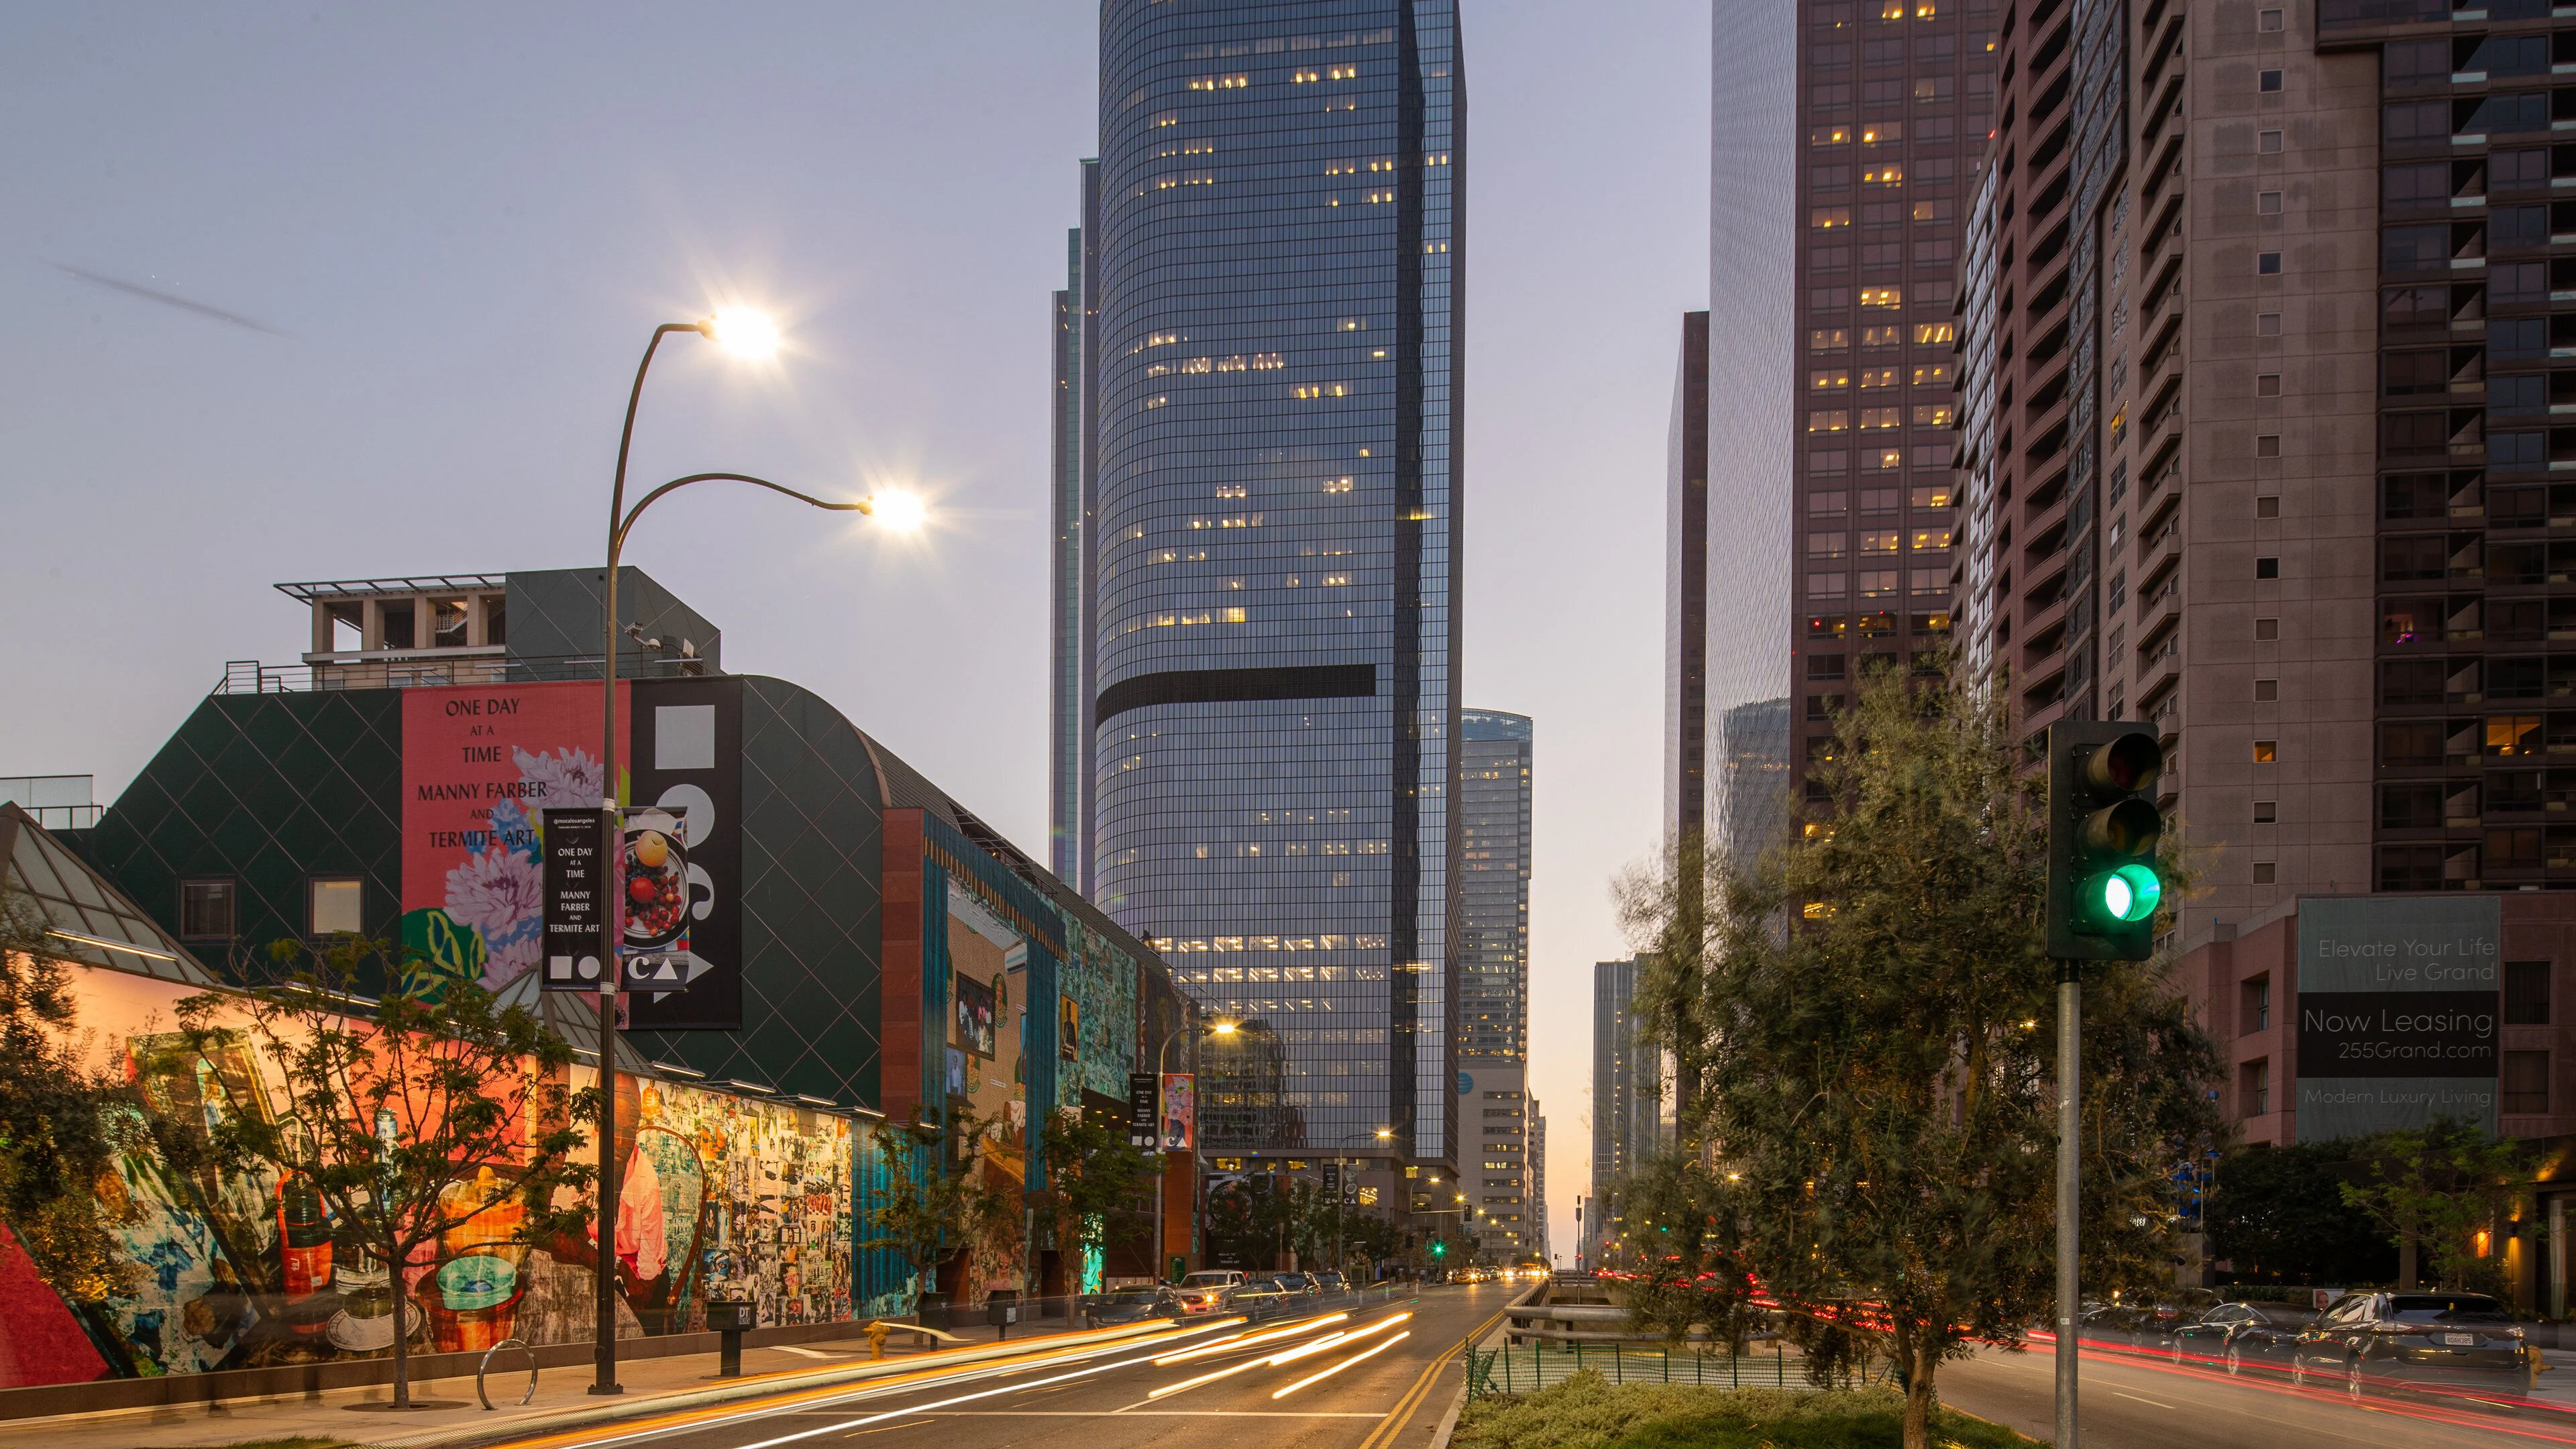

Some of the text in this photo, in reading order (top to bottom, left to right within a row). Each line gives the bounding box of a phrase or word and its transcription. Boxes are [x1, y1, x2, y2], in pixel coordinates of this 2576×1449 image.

[445, 698, 520, 716] ONE DAY
[470, 725, 494, 736] AT A
[462, 746, 501, 763] TIME
[418, 782, 547, 800] MANNY FARBER
[470, 809, 494, 819] AND
[429, 829, 535, 848] TERMITE ART
[557, 848, 593, 856] ONE DAY
[566, 869, 585, 878] TIME
[560, 891, 590, 899] MANNY
[561, 903, 590, 911] FARBER
[549, 924, 600, 932] TERMITE ART
[2319, 937, 2495, 957] Elevate Your Life
[2376, 962, 2495, 981] Live Grand
[2305, 1008, 2493, 1038] Now Leasing
[2339, 1041, 2491, 1059] 255Grand.com
[2304, 1088, 2491, 1108] Modern Luxury Living
[739, 1307, 750, 1318] DT
